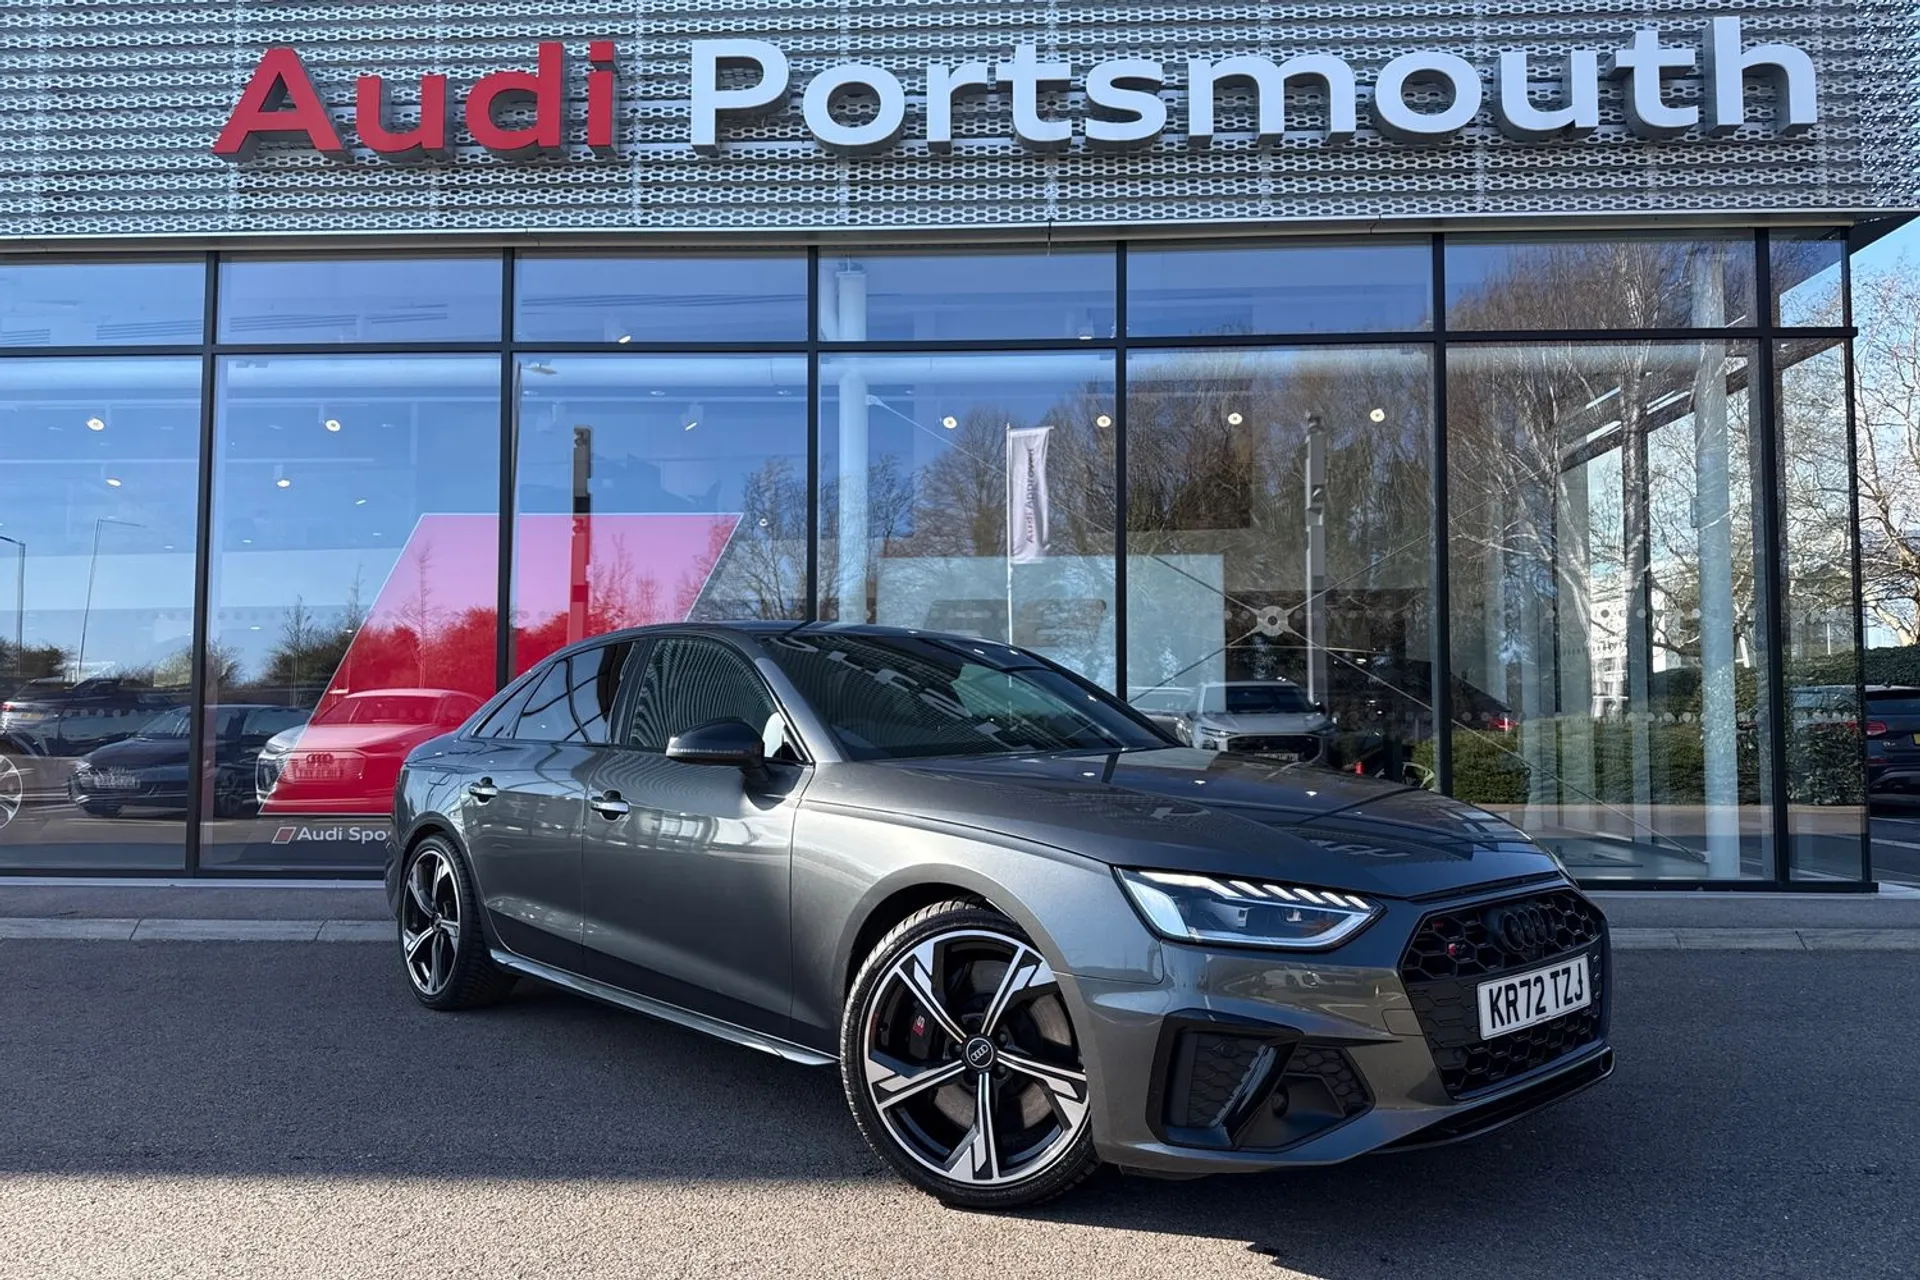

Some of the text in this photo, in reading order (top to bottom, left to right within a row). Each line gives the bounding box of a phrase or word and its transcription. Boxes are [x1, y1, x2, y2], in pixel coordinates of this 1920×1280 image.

[213, 17, 1819, 156] Audi Portsmouth
[1026, 512, 1035, 543] Audi
[296, 826, 343, 841] Audi
[1489, 963, 1584, 1029] KR72 TZJ
